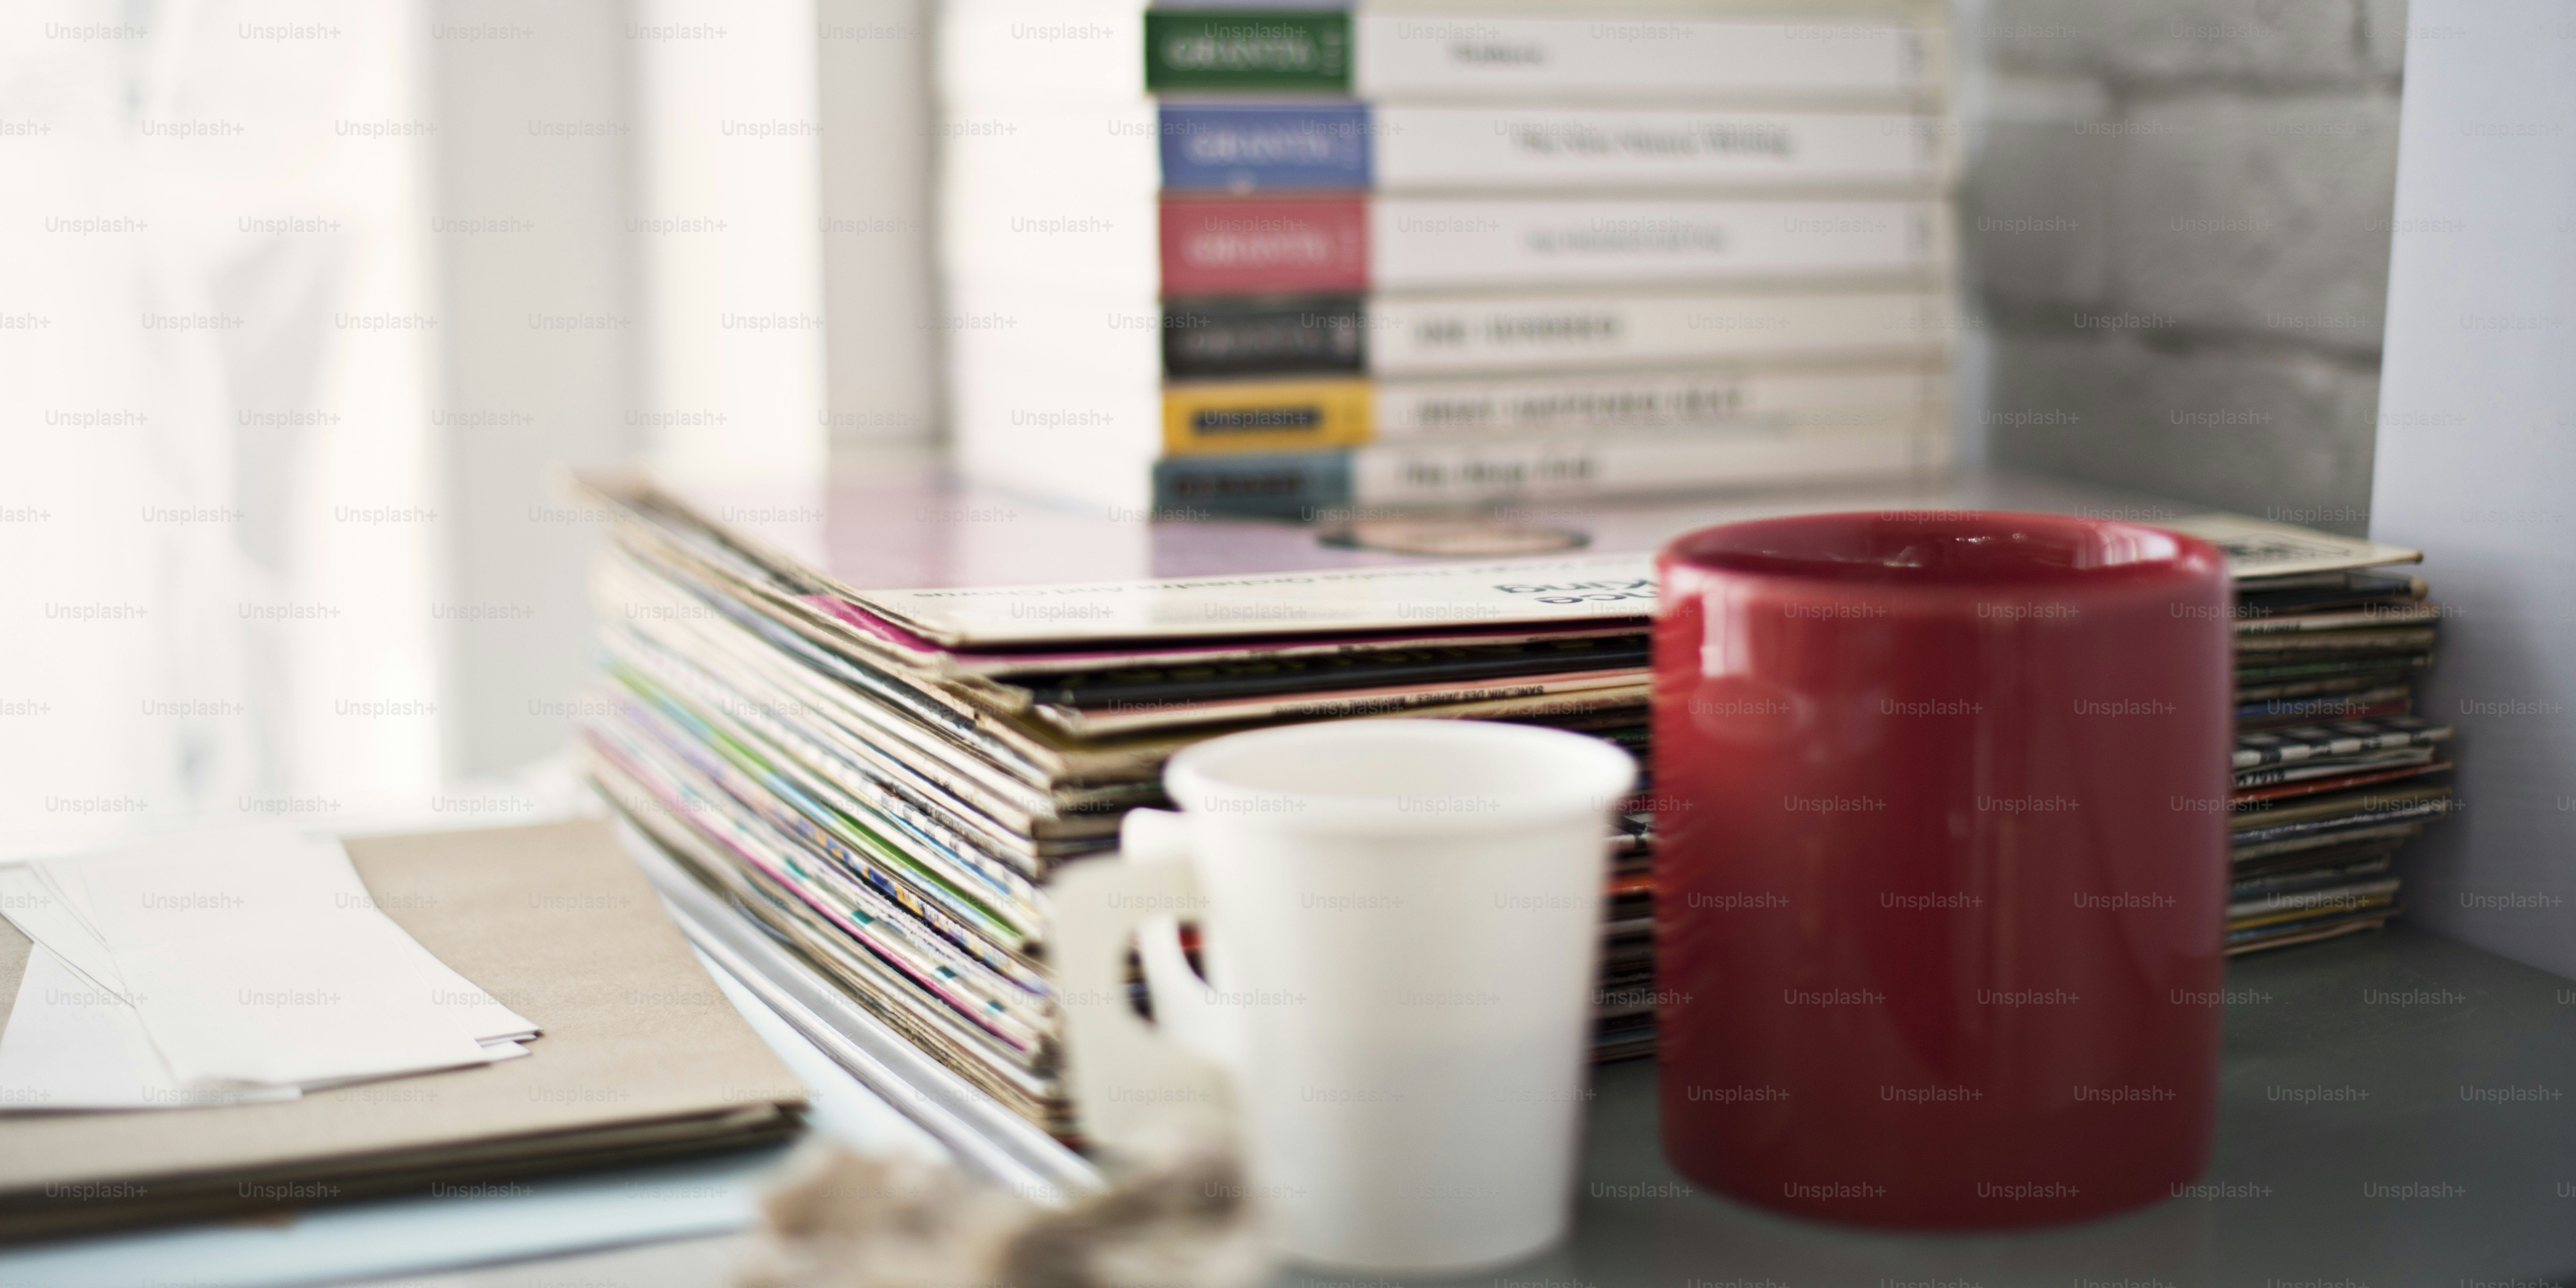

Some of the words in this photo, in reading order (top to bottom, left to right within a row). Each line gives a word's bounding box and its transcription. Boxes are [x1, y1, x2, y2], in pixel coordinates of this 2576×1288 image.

[1136, 575, 1315, 590] Orchestra
[912, 590, 1046, 598] Chorus
[1056, 586, 1124, 595] And
